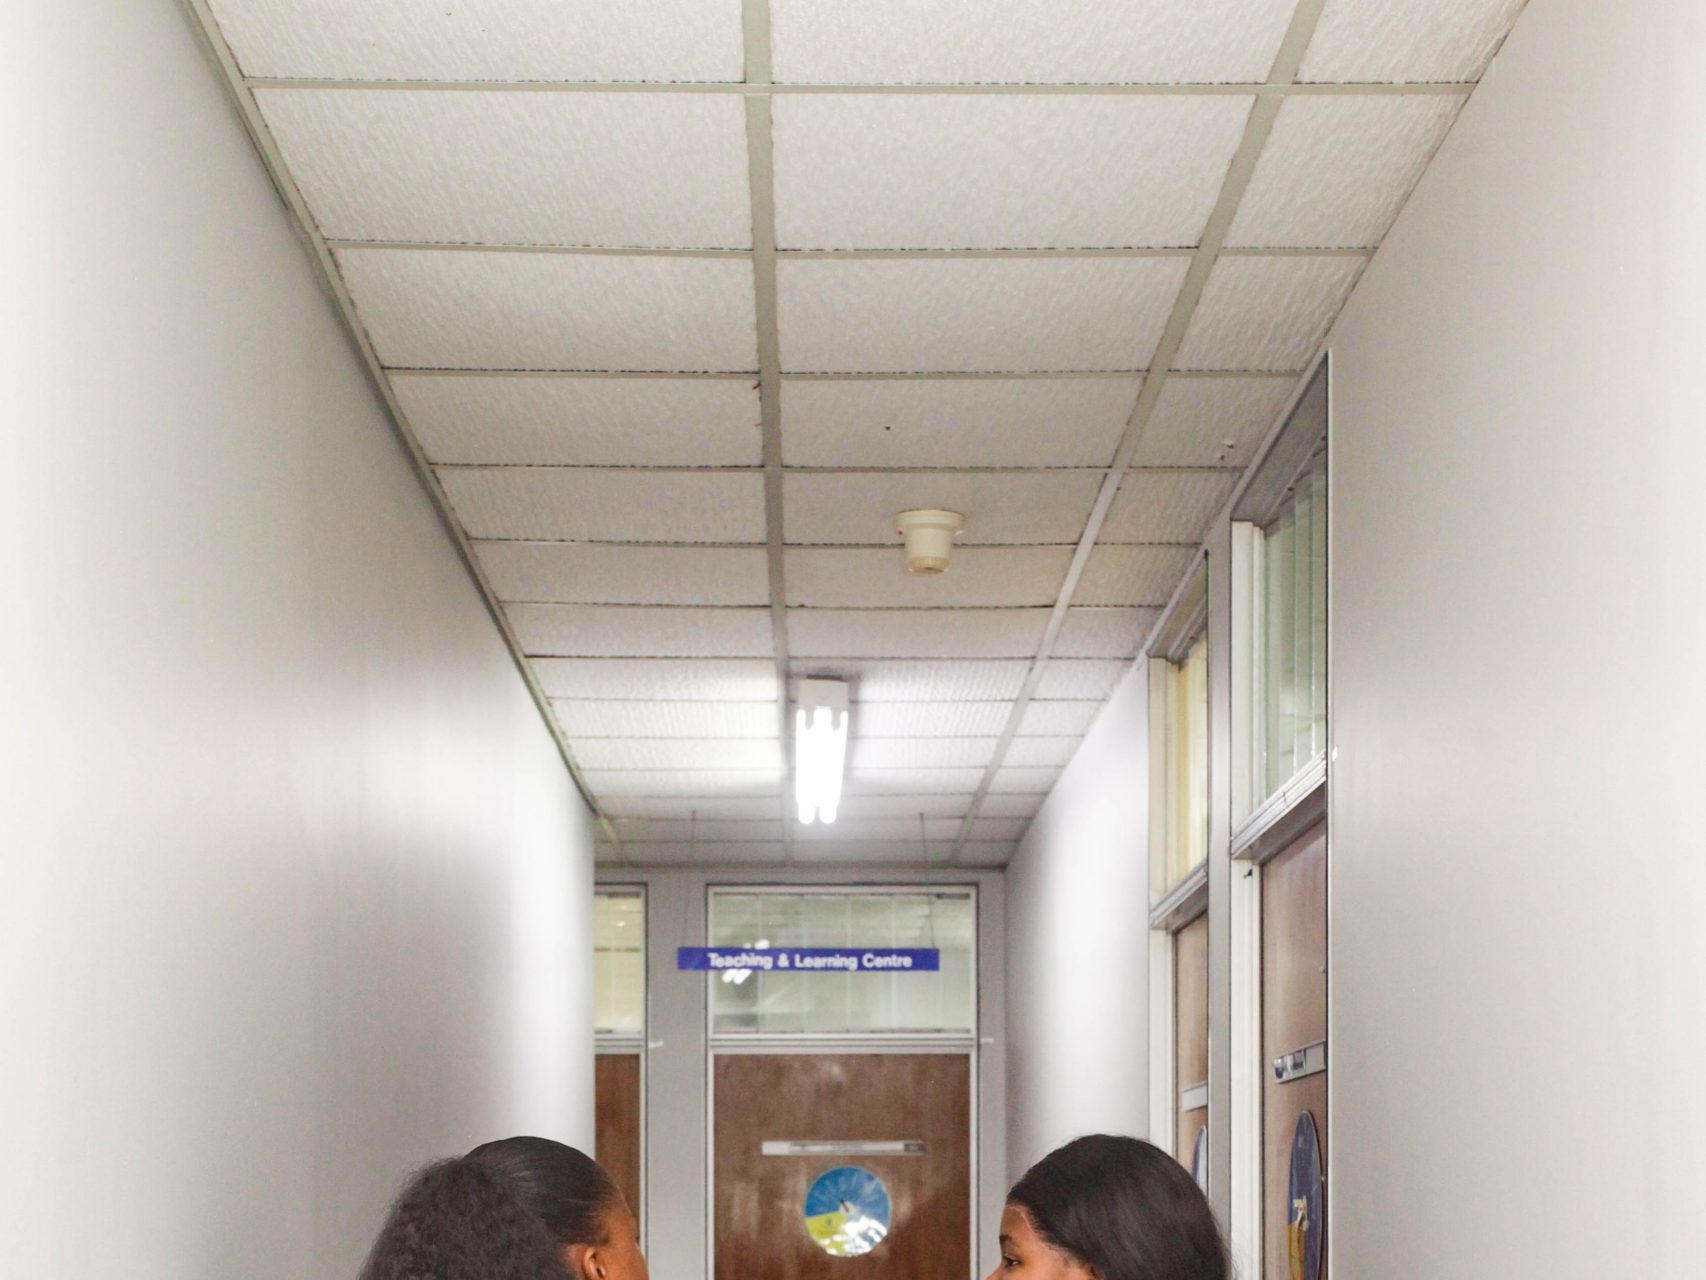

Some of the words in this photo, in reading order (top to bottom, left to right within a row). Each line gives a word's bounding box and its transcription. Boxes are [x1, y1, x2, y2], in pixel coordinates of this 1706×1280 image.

[707, 952, 773, 970] Teaching
[777, 953, 789, 968] &
[794, 953, 858, 971] Learning
[862, 952, 913, 968] Centre
